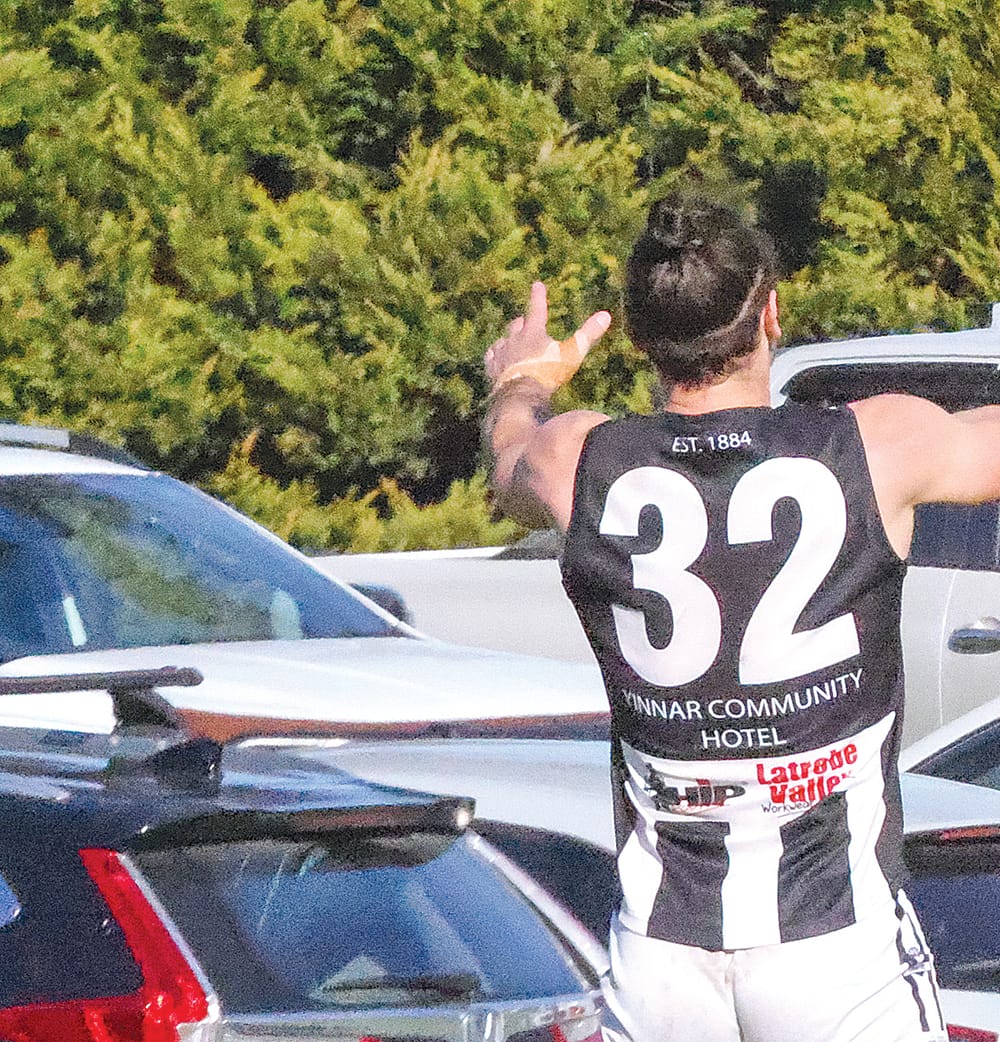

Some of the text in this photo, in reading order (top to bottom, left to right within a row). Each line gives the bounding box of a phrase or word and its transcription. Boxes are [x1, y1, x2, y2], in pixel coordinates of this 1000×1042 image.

[672, 430, 752, 453] EST. 1884
[600, 457, 861, 687] 32
[622, 668, 863, 720] YINNAR COMMUNITY
[701, 727, 787, 749] HOTEL
[756, 743, 858, 785] Latrobe
